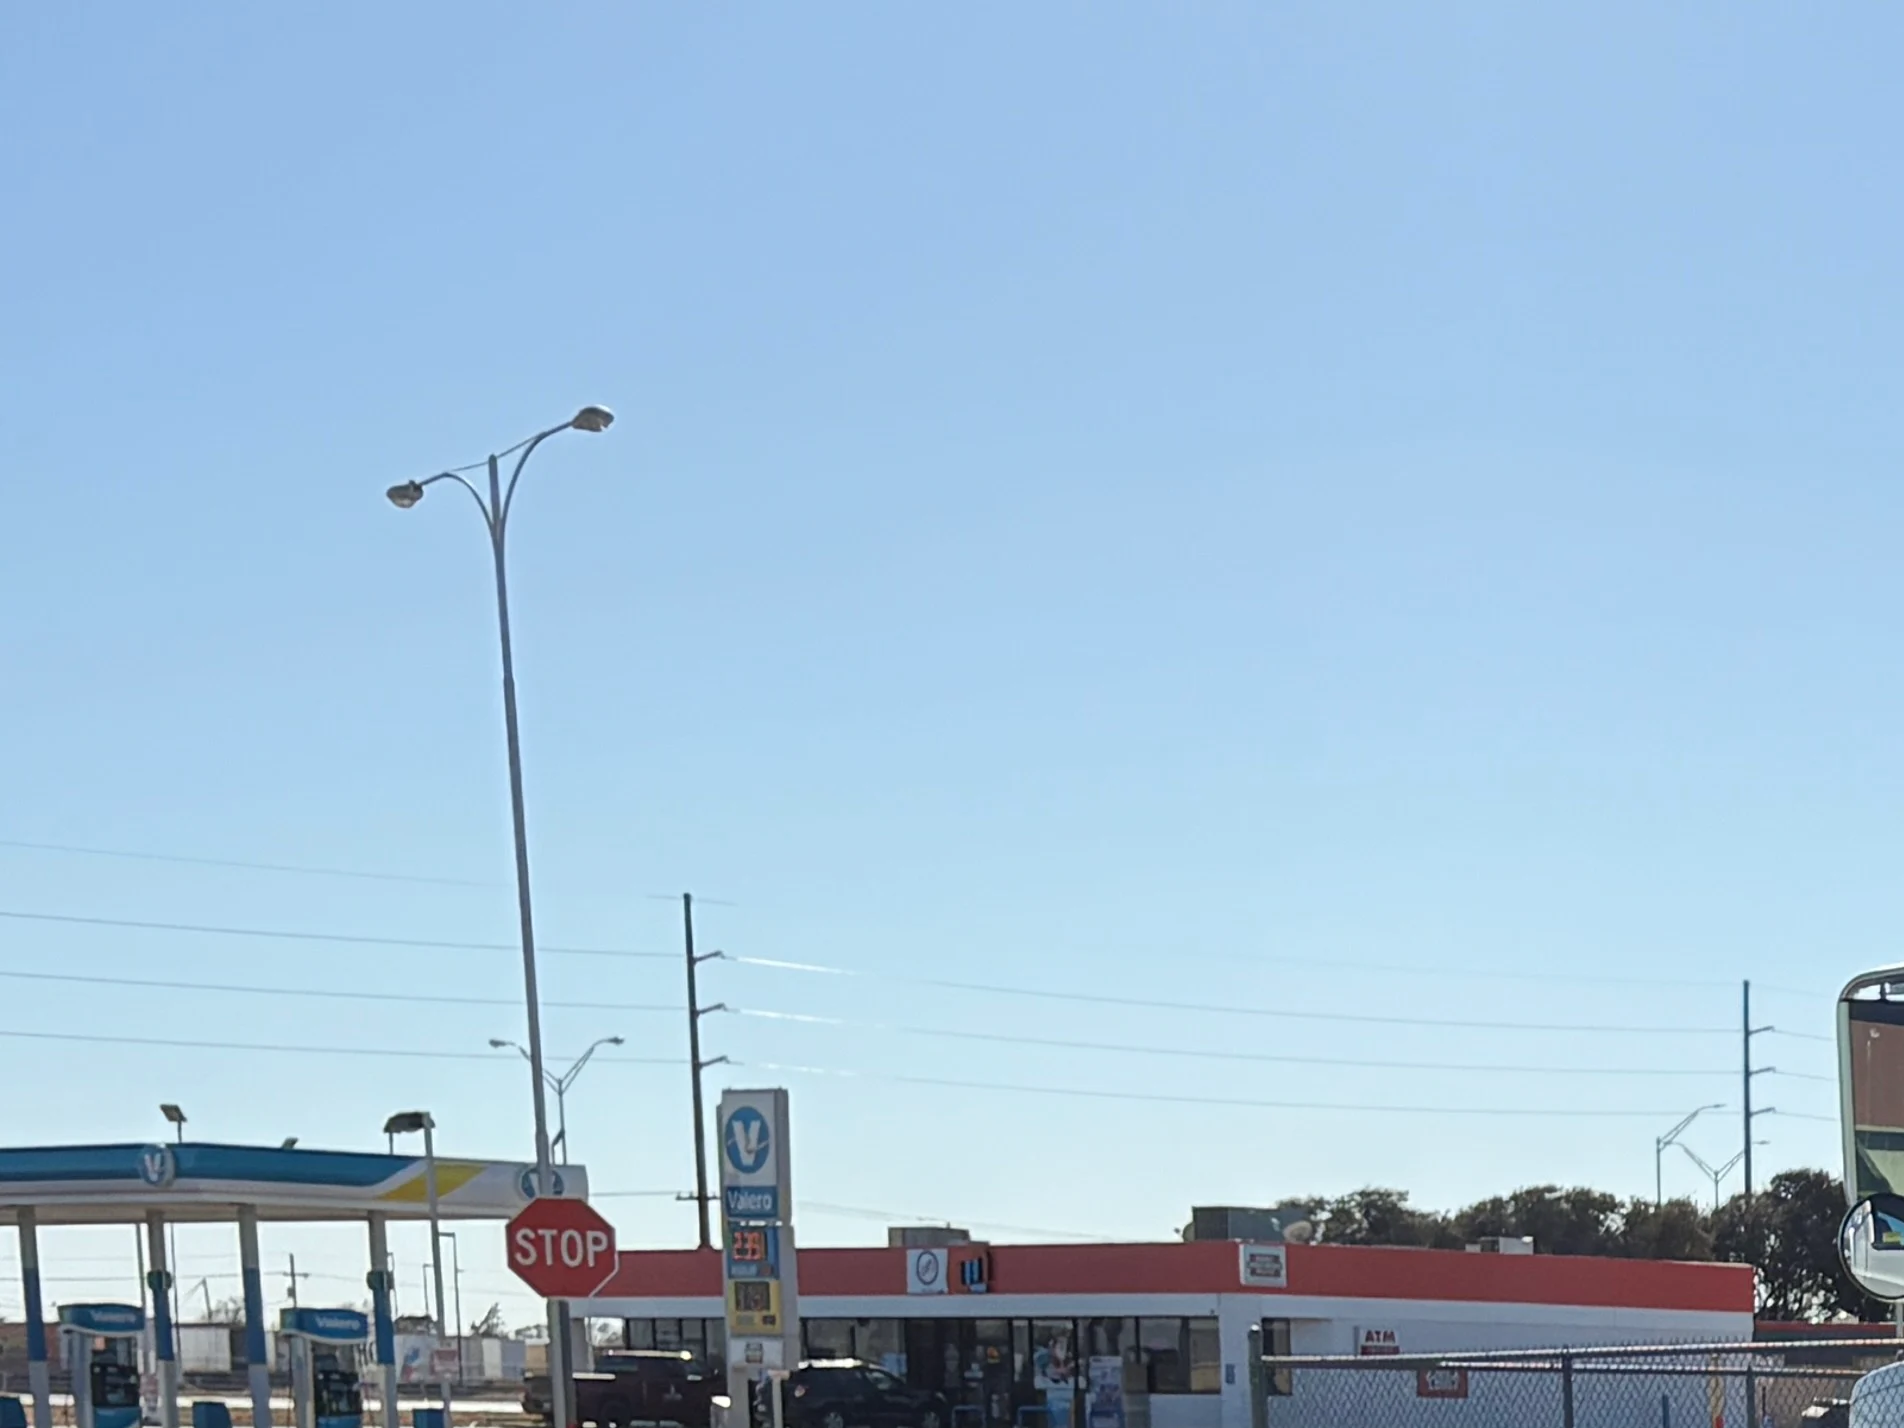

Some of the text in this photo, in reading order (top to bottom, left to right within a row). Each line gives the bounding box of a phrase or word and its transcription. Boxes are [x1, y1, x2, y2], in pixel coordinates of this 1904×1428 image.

[727, 1189, 773, 1211] Valero
[514, 1228, 608, 1268] STOP
[1364, 1330, 1397, 1344] ATM
